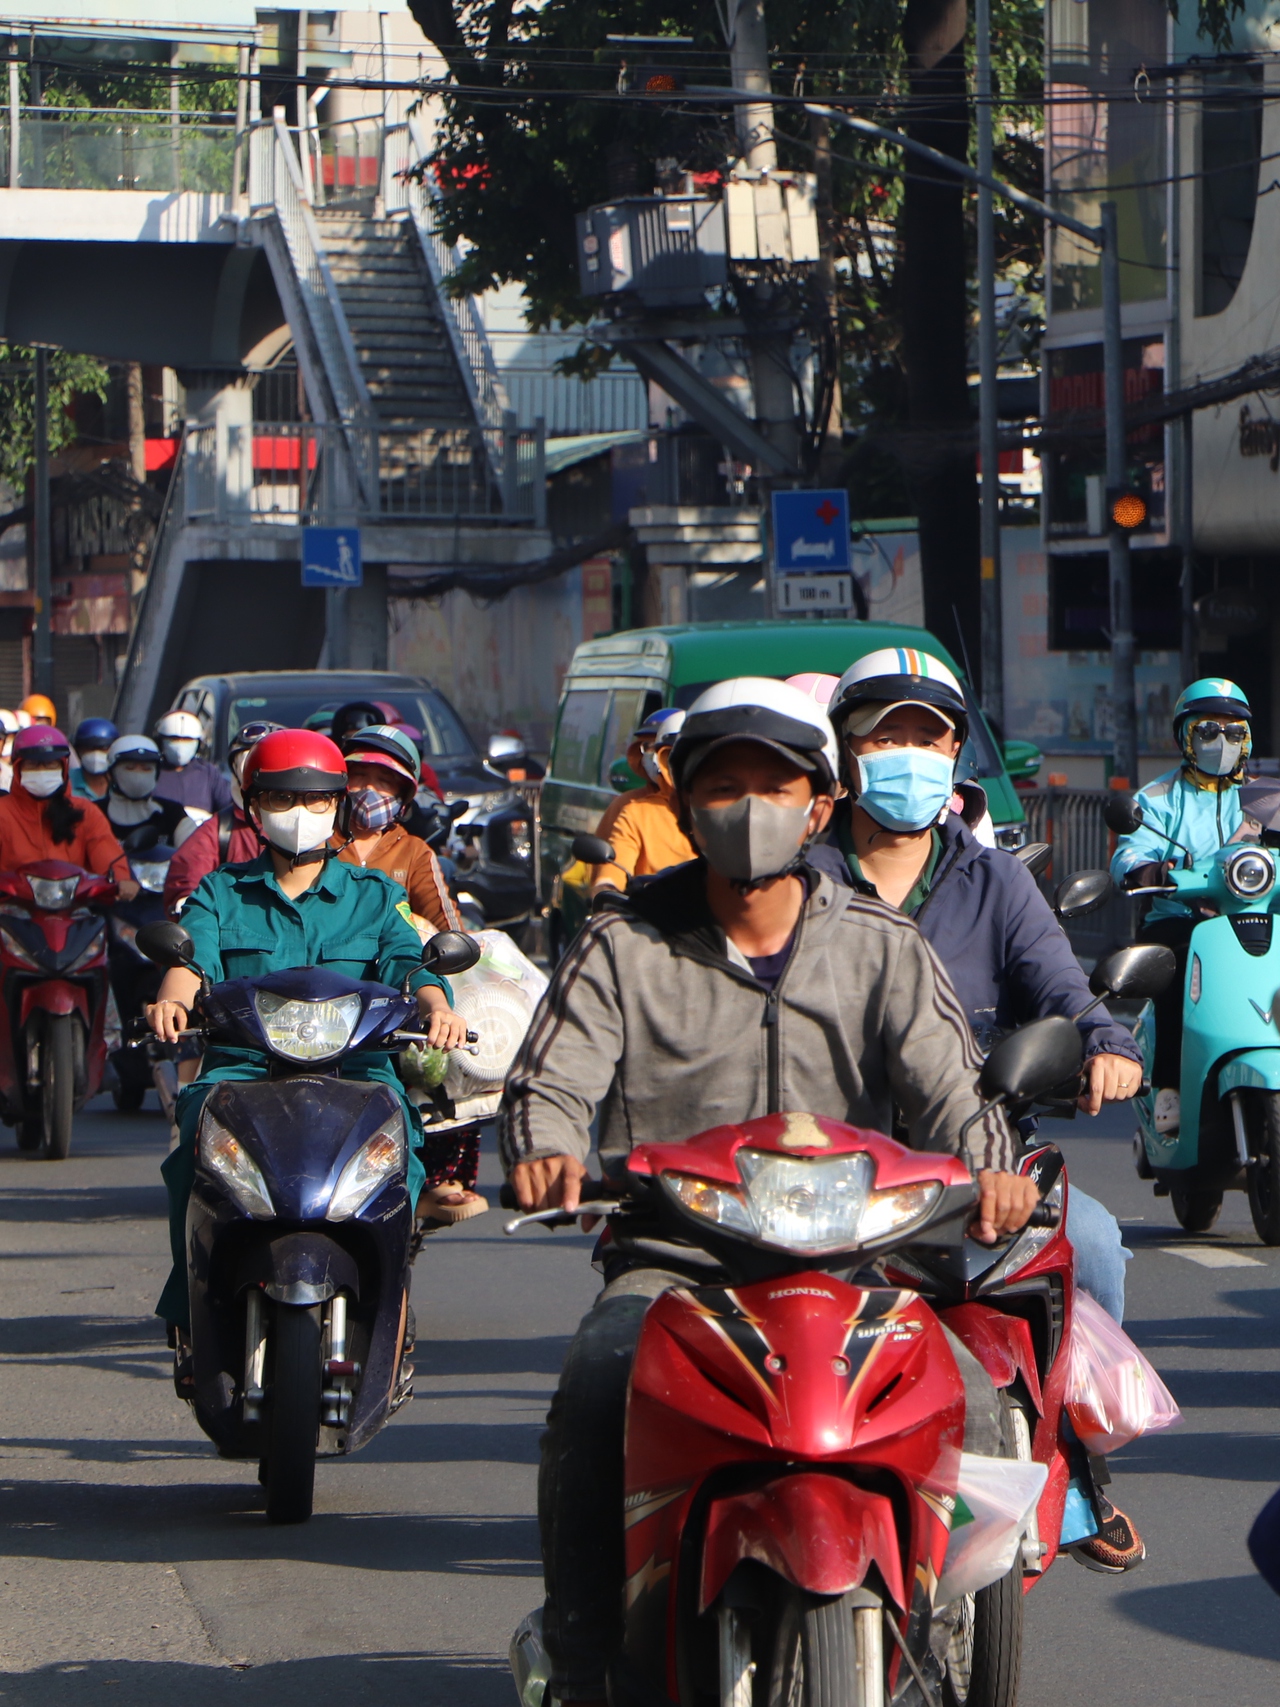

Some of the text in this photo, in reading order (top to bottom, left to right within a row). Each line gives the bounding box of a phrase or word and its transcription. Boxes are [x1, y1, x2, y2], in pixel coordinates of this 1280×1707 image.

[285, 1078, 325, 1086] HONDA
[194, 1198, 218, 1219] HONDA
[383, 1200, 406, 1222] HONDA
[768, 1287, 836, 1300] HONDA
[857, 1323, 906, 1339] WAVE
